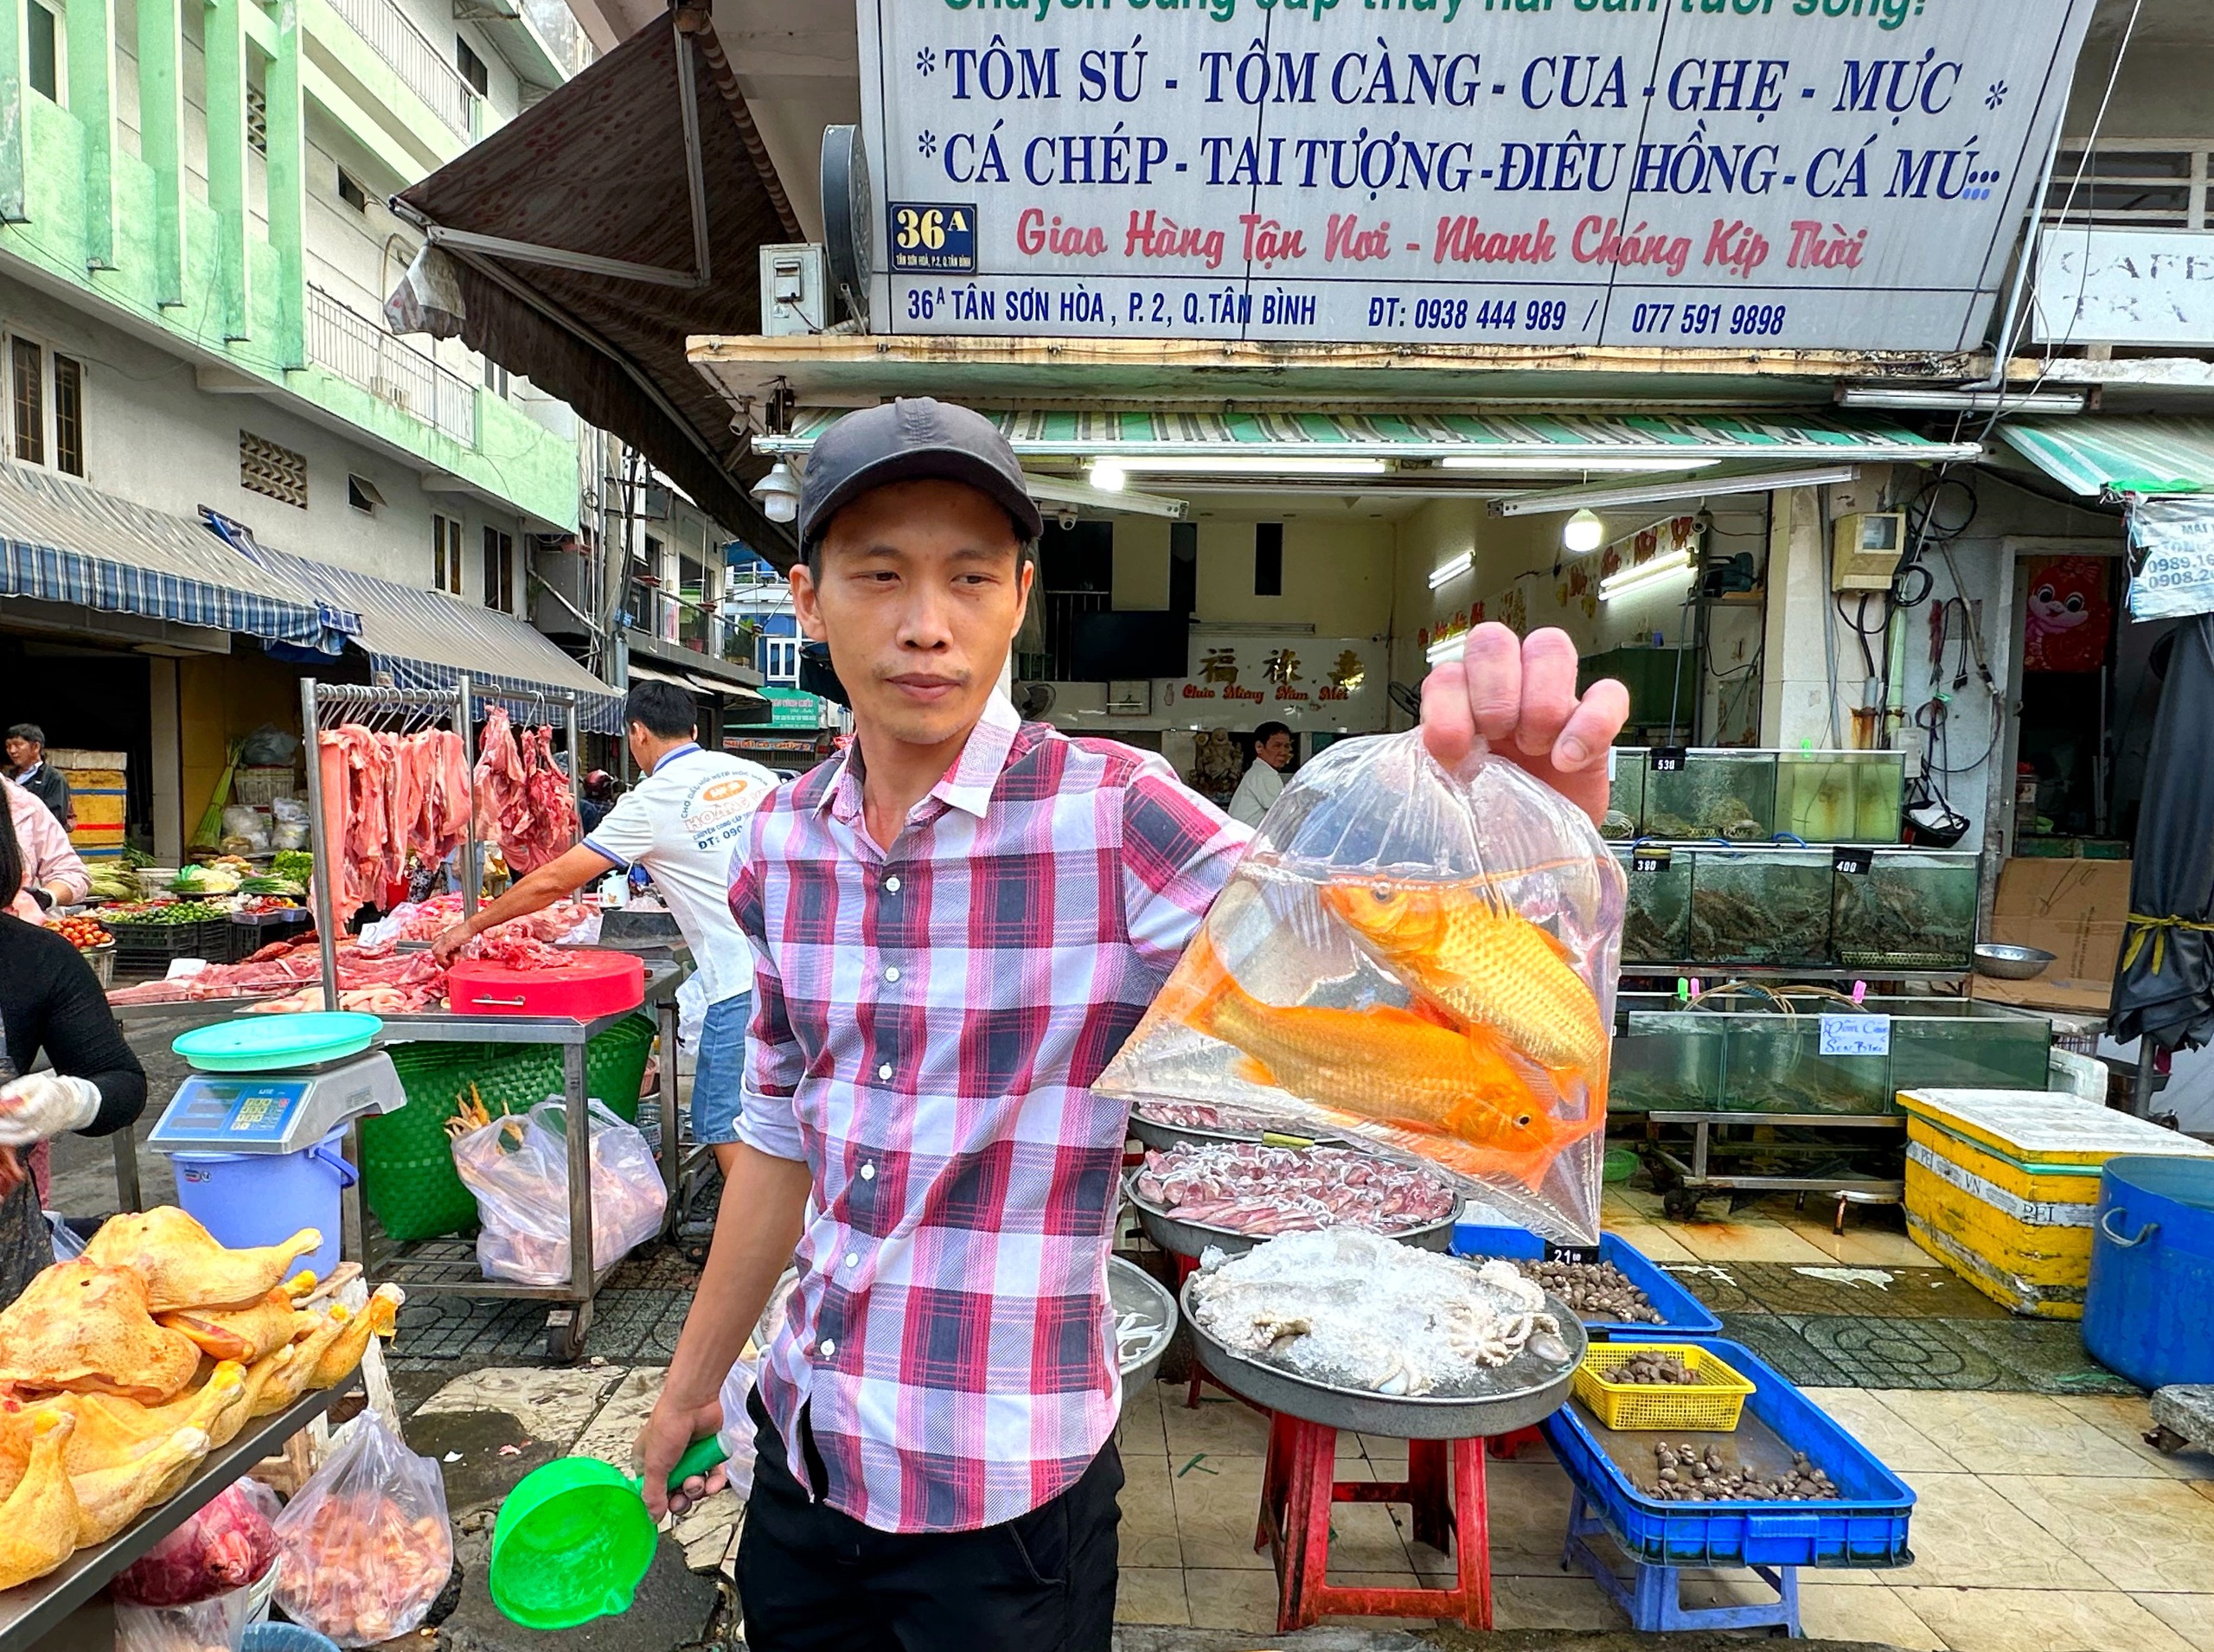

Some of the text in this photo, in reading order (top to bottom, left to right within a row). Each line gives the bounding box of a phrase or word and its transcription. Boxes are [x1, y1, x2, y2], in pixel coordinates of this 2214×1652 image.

[1079, 34, 1145, 102] SÚ
[1200, 37, 1320, 106] TÔM
[1331, 35, 1481, 106] CÀNG
[1521, 55, 1627, 110] CUA
[1667, 59, 1791, 125] GHẸ
[1834, 47, 1963, 126] MỰC
[1201, 137, 1285, 187] TAI
[1016, 208, 1106, 257] Giao
[1124, 209, 1225, 270] Hàng
[1239, 212, 1305, 268] Tận
[1325, 214, 1390, 261] Nơi
[1434, 215, 1556, 264] Nhanh
[1571, 215, 1692, 277] Chóng
[1704, 219, 1769, 276] Kịp
[1788, 221, 1867, 268] Thời
[951, 286, 995, 321] TÂN
[1005, 286, 1049, 322] SƠN
[1263, 295, 1315, 324] BÌNH
[1368, 297, 1406, 328] ĐT:
[1415, 299, 1468, 329] 0938
[1476, 300, 1516, 328] 444
[1526, 301, 1565, 330] 989
[1632, 304, 1674, 332] 077
[1681, 304, 1721, 334] 591
[1731, 305, 1786, 335] 9898
